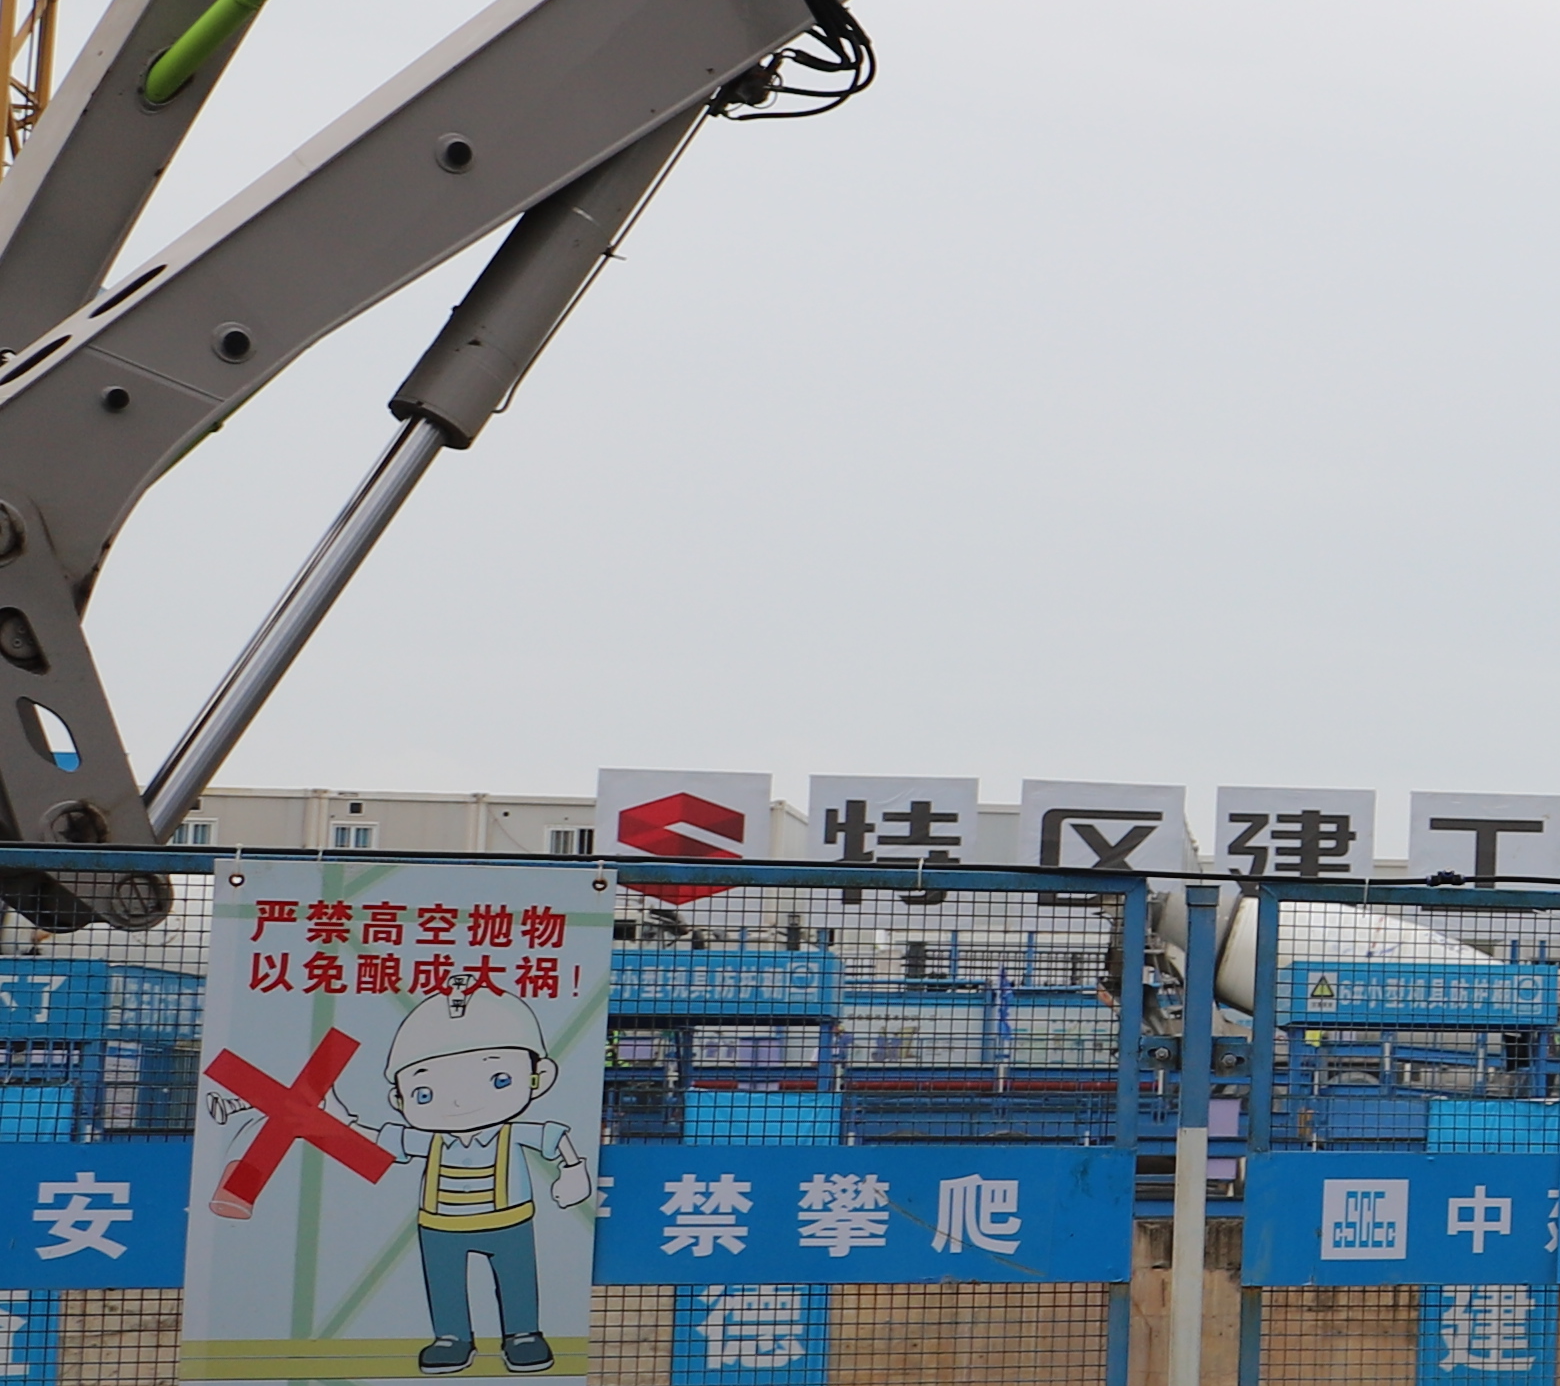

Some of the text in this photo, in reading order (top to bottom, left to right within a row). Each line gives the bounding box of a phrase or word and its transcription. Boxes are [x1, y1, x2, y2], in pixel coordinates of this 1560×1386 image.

[250, 899, 567, 948] 严禁高空抛物
[249, 951, 581, 998] 以免酿成大祸!
